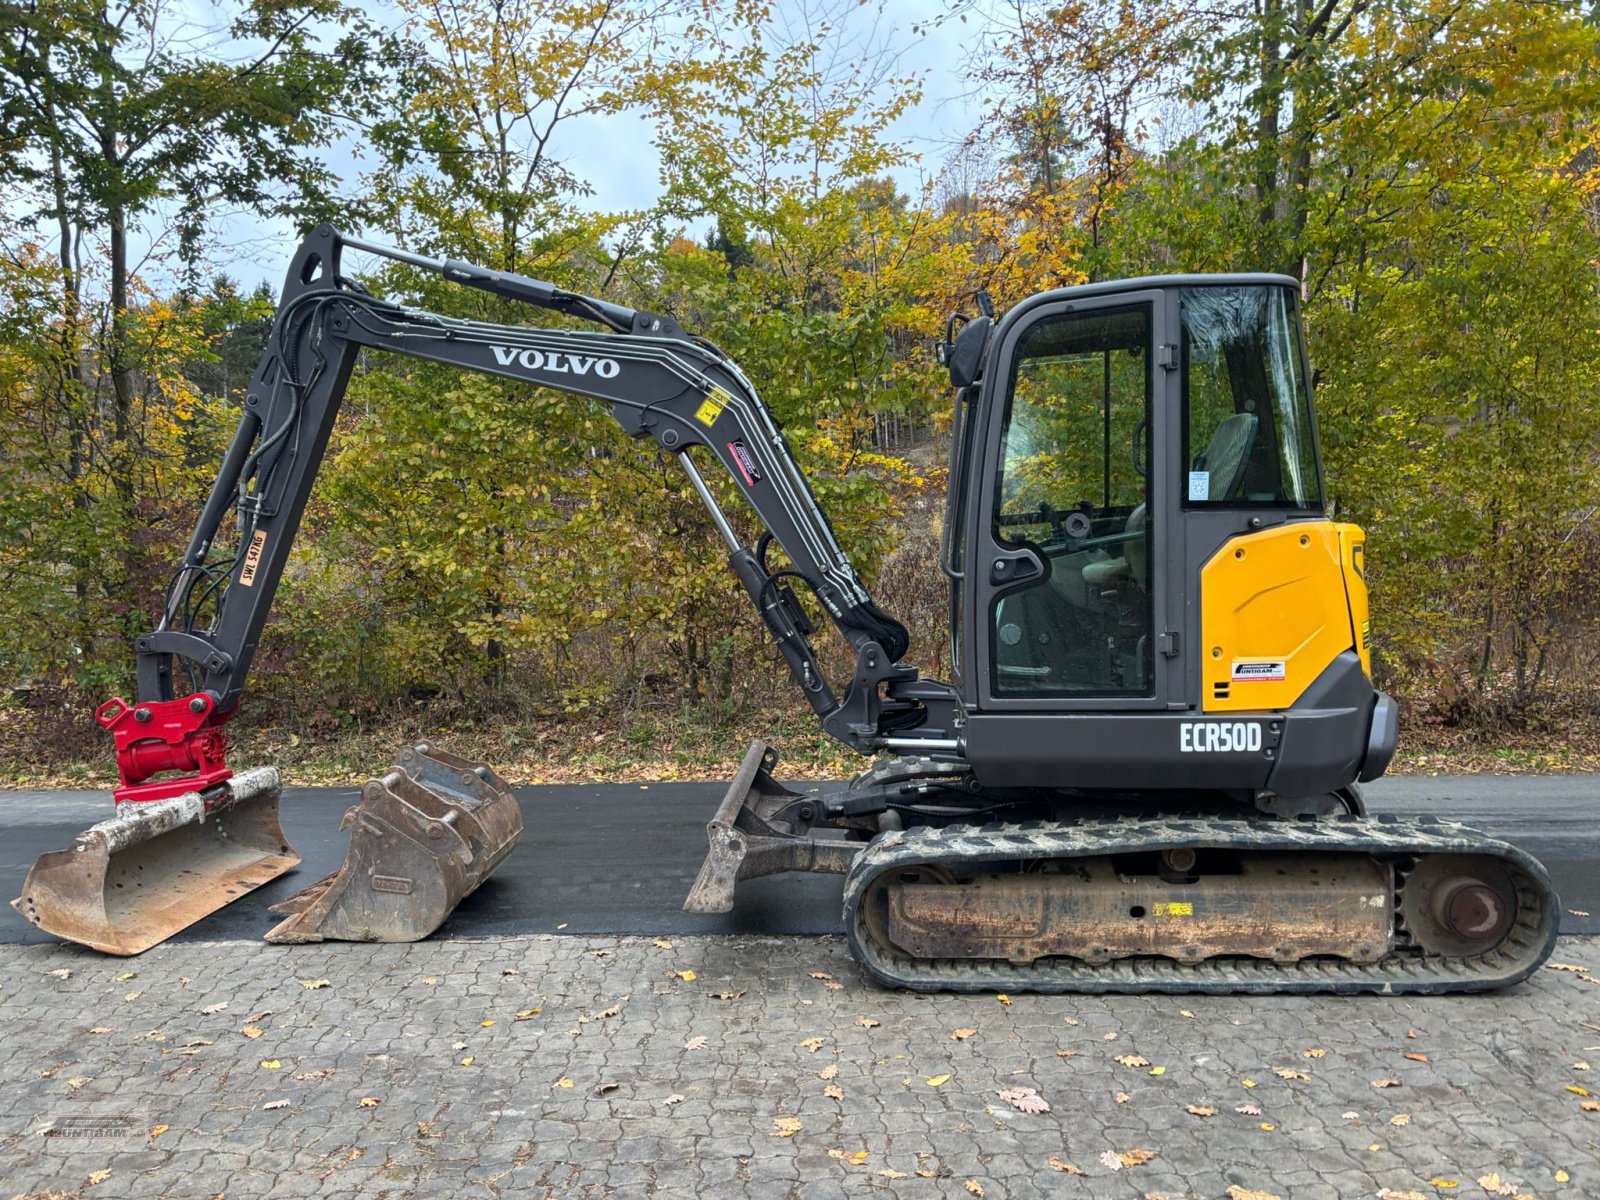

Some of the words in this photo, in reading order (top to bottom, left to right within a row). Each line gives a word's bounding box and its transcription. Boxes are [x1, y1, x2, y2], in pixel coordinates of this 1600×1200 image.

[489, 345, 620, 378] VOLVO
[247, 536, 263, 562] 547KG
[242, 564, 256, 580] SWL
[1180, 722, 1262, 752] ECR50D
